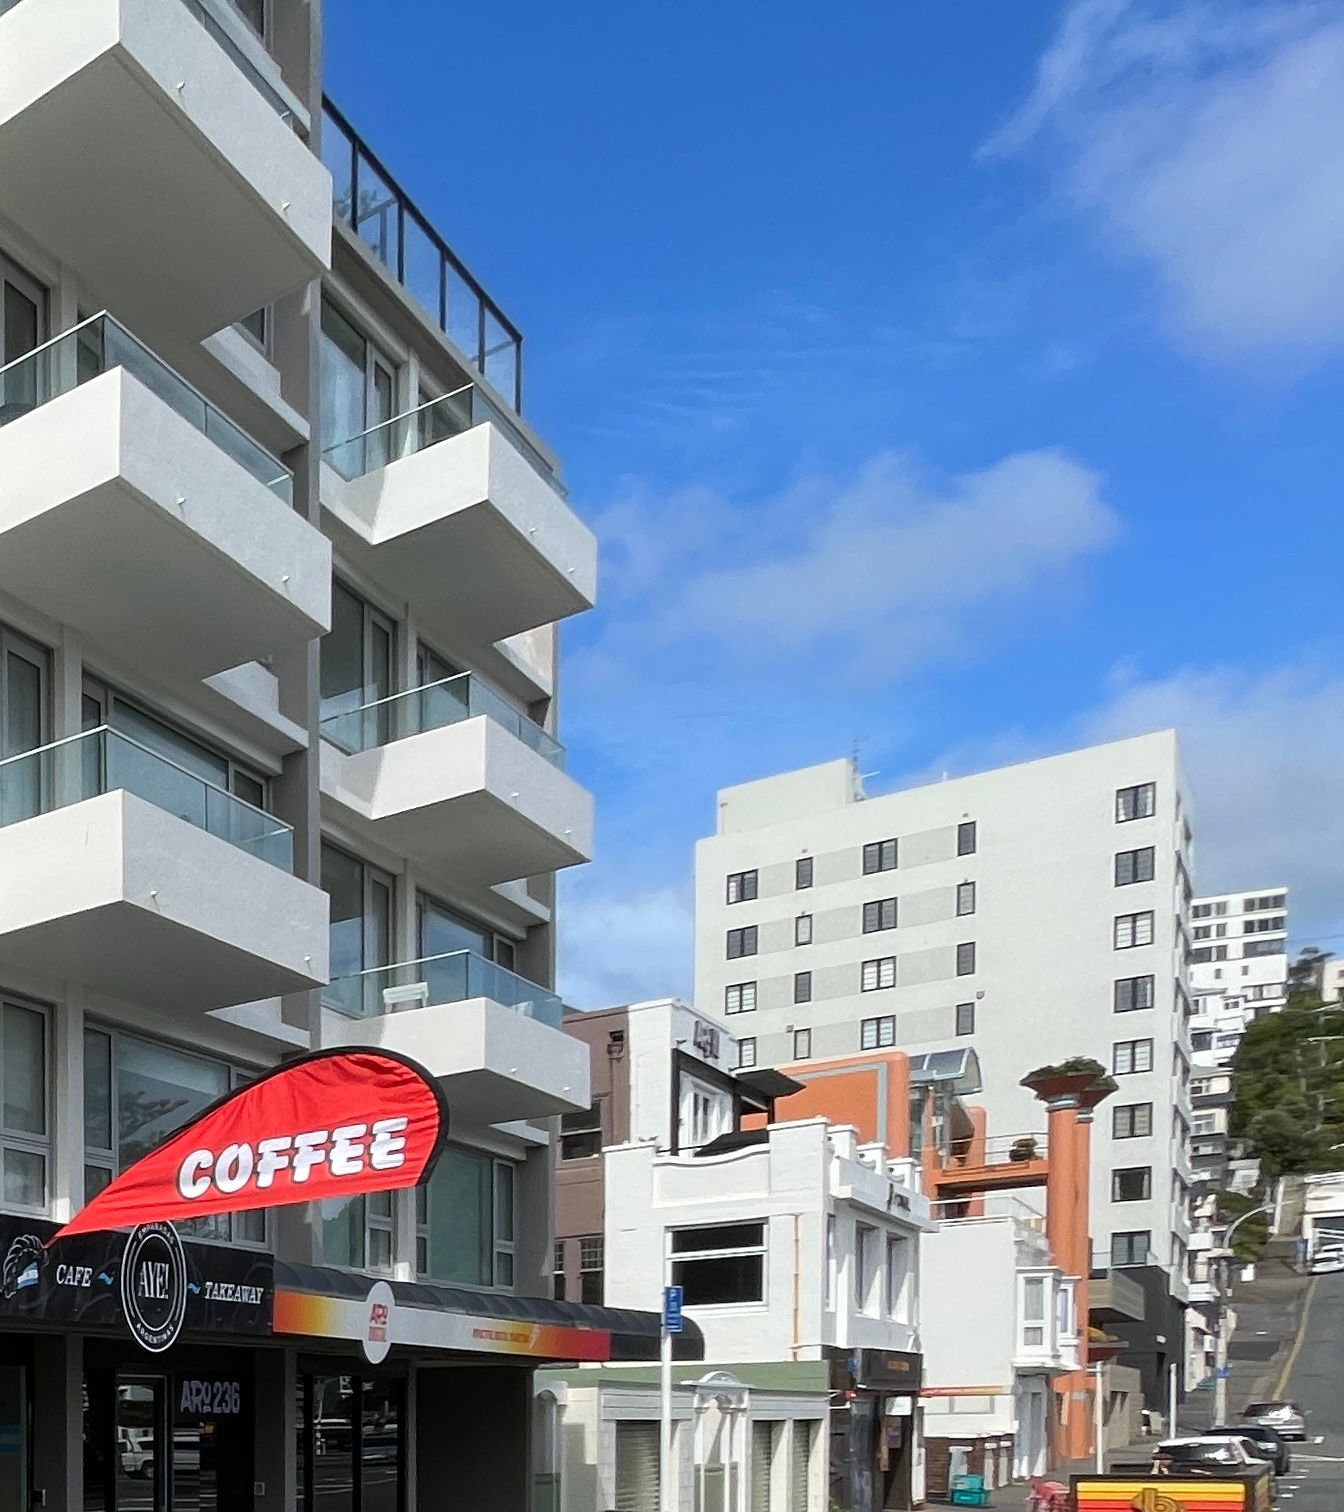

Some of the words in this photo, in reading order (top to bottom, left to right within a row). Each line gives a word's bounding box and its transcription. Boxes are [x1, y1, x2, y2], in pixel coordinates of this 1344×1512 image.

[176, 1116, 410, 1200] COFFEE
[55, 1263, 93, 1288] CAFE
[137, 1260, 169, 1301] AYE!
[204, 1281, 264, 1305] TAKEAWAY
